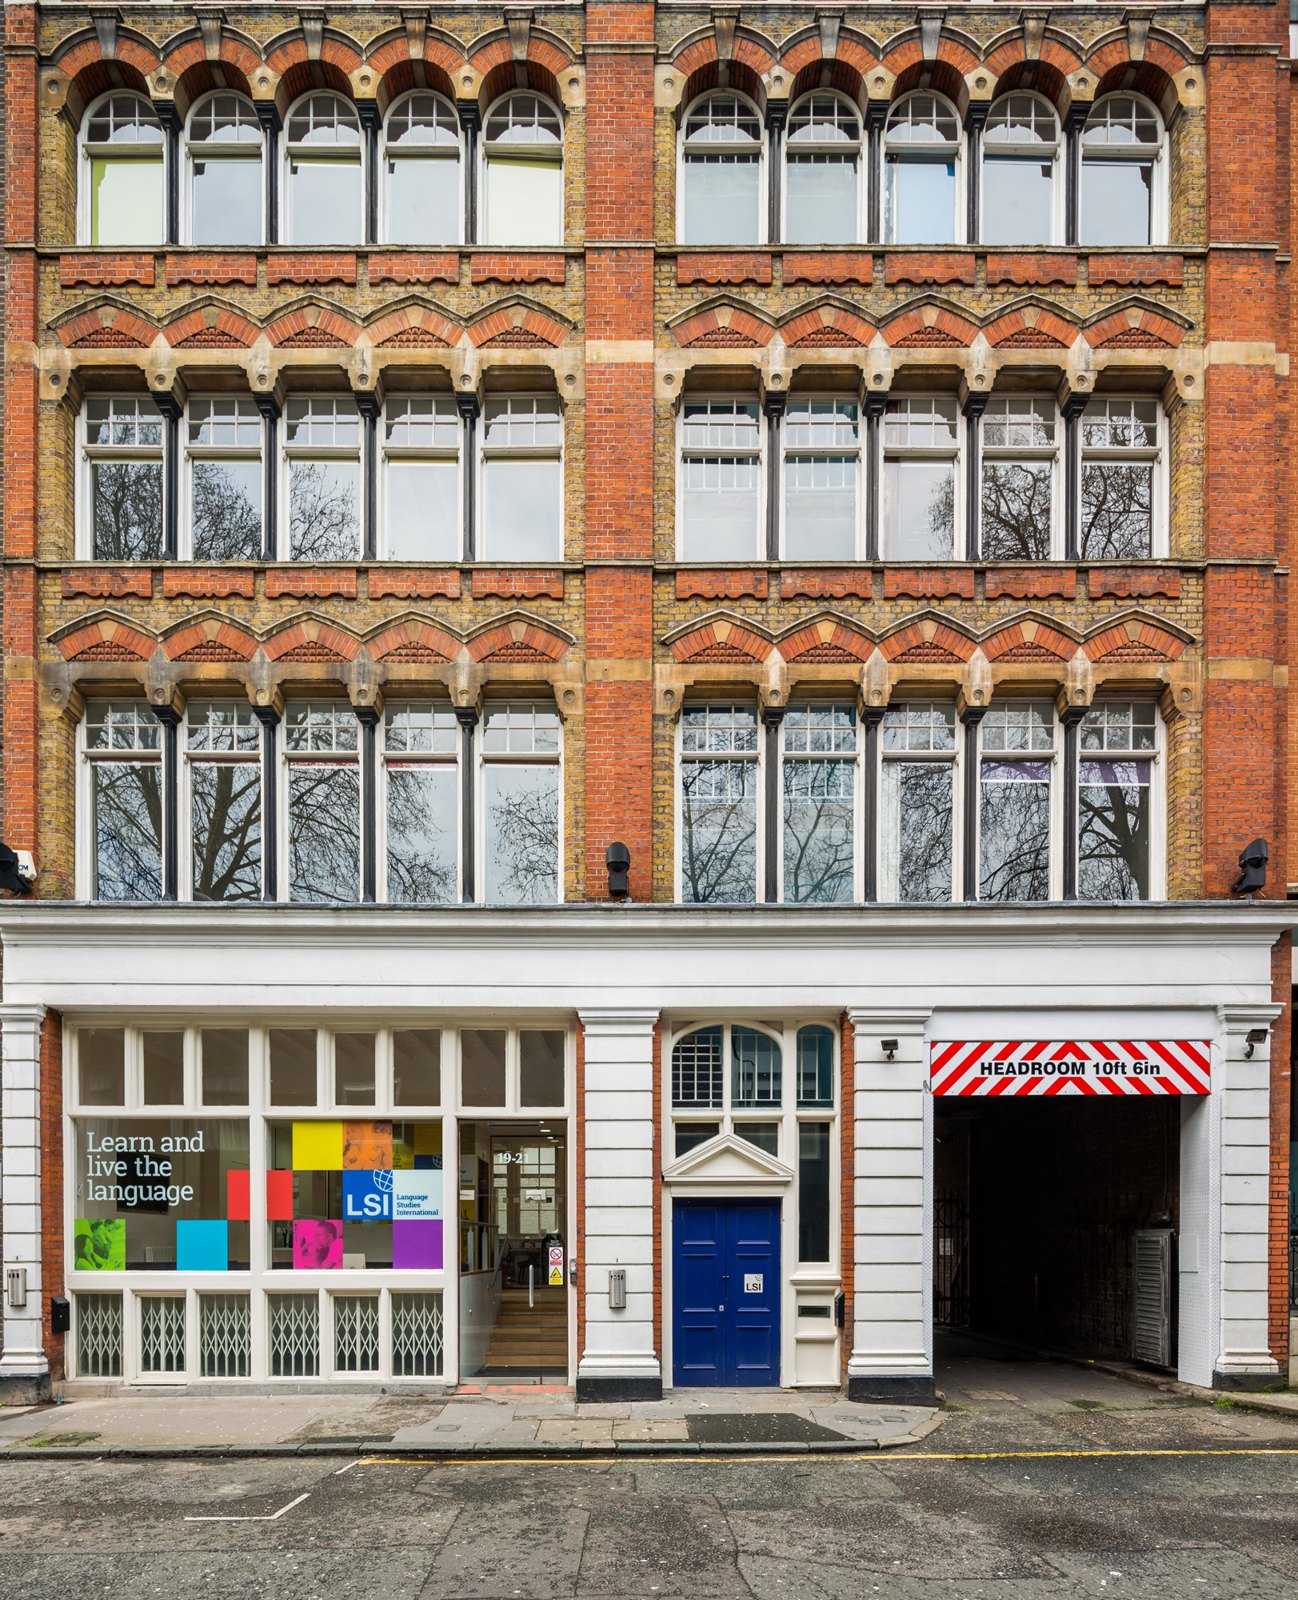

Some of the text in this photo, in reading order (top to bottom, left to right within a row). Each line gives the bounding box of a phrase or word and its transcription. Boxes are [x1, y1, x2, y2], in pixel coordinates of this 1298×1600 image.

[980, 1061, 1161, 1075] HEADROOM 10ft 6in
[87, 1131, 205, 1152] Learn and
[87, 1155, 172, 1176] live the
[497, 1152, 529, 1164] 19-21
[87, 1179, 194, 1206] language
[347, 1193, 389, 1216] LSI
[746, 1282, 761, 1291] LSI
